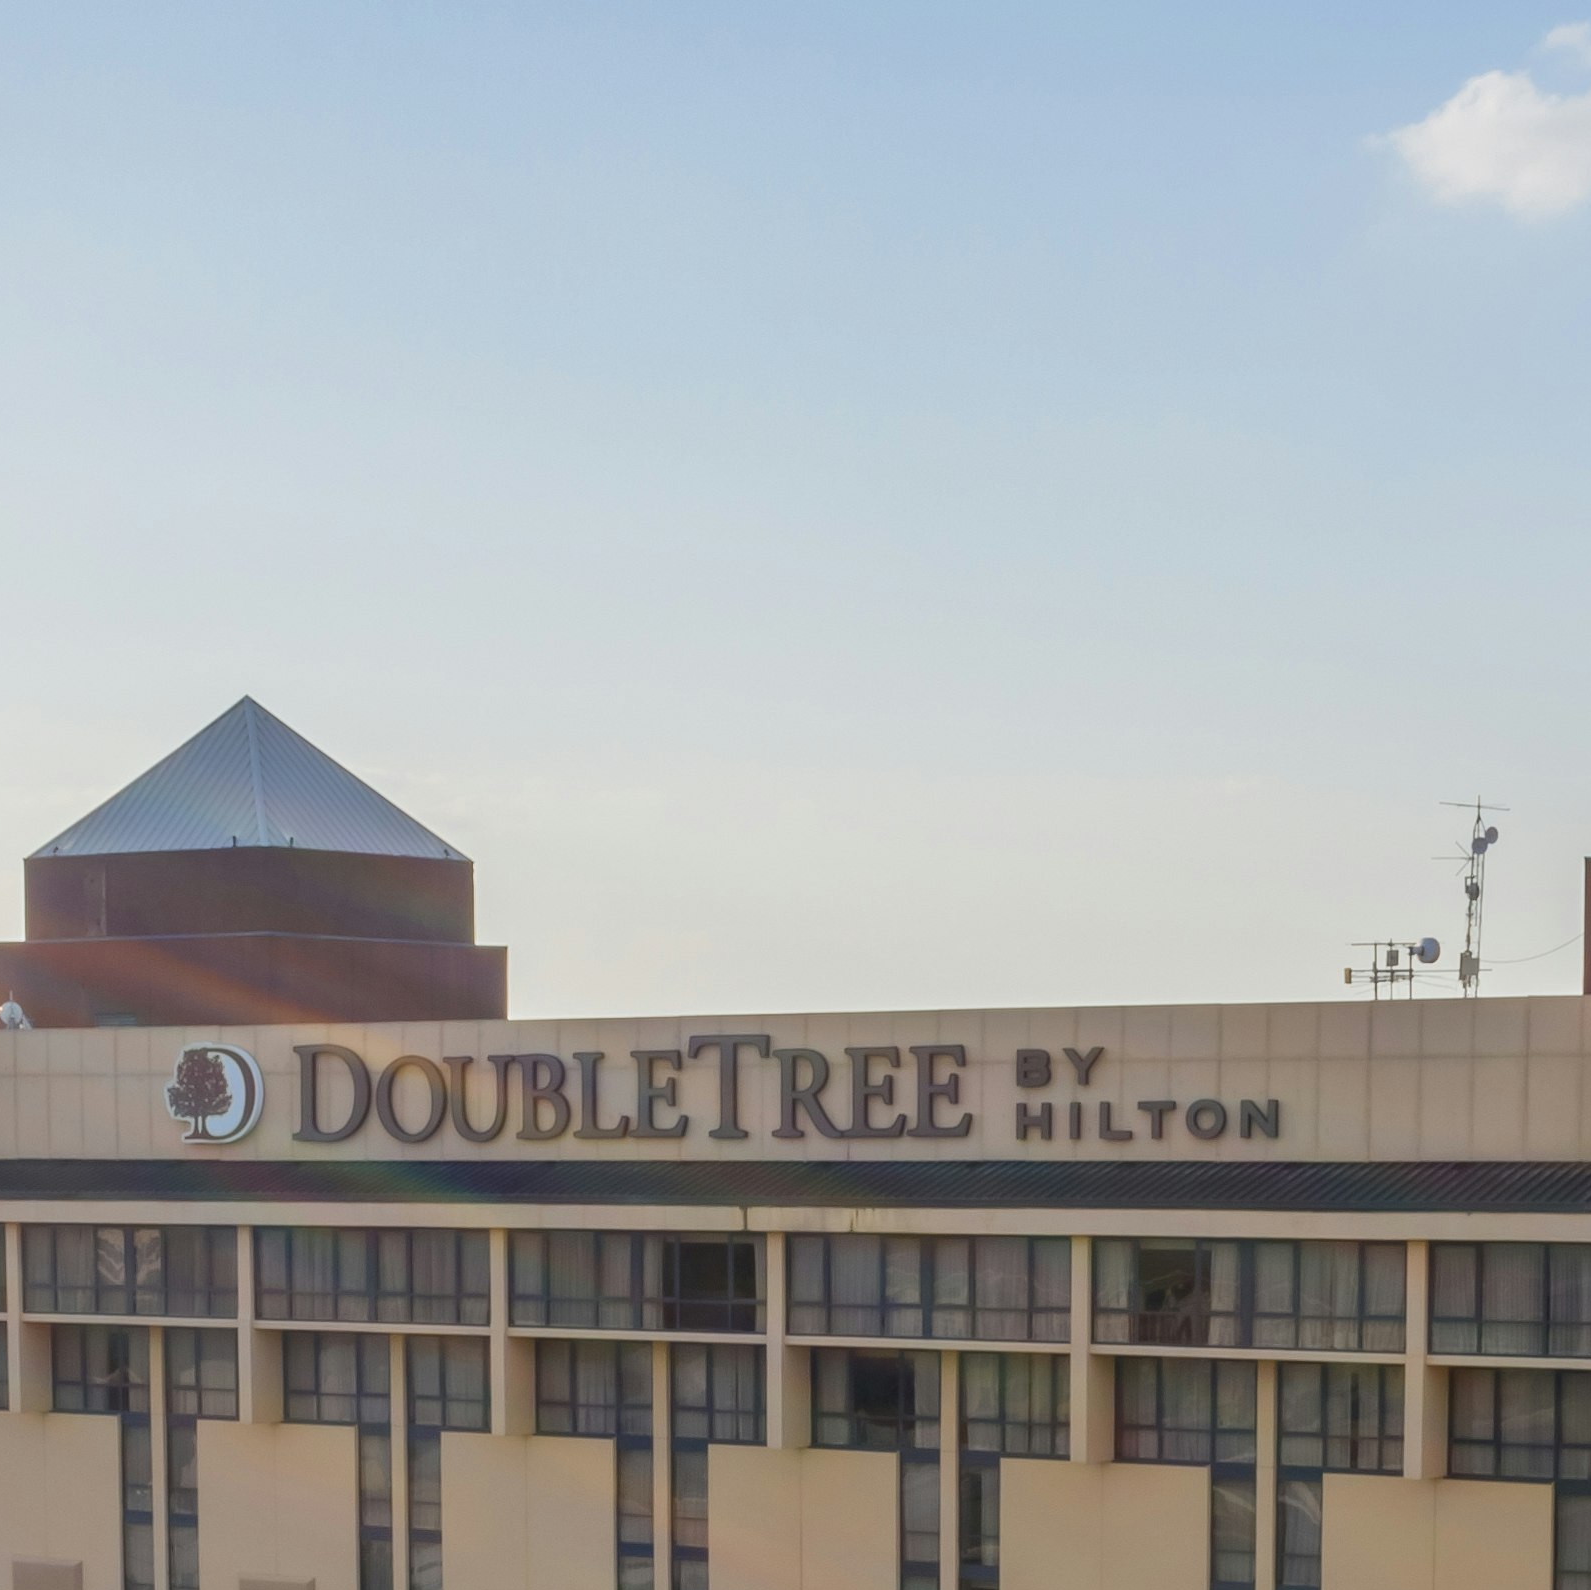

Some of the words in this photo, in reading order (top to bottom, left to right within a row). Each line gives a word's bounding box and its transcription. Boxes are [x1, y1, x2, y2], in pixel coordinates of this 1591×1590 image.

[1015, 1046, 1105, 1088] BY
[292, 1034, 973, 1144] DOUBLETREE
[1015, 1098, 1280, 1141] HILTON
